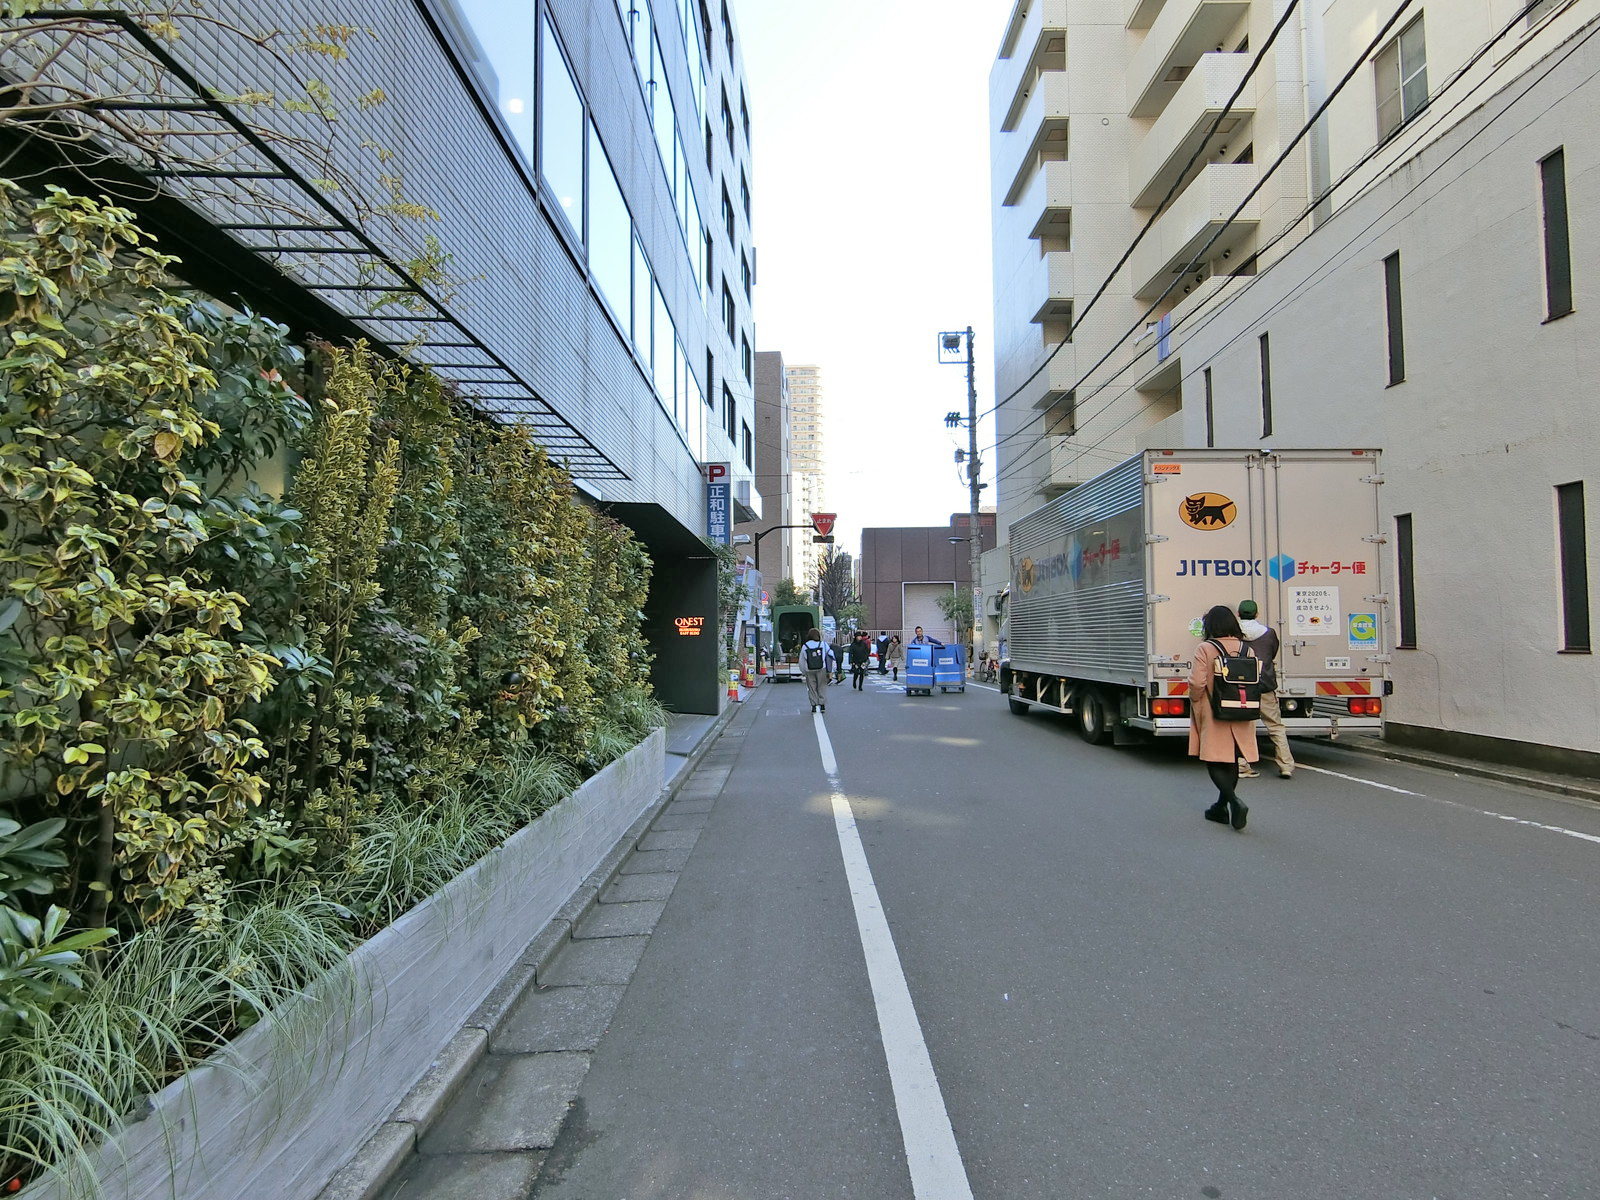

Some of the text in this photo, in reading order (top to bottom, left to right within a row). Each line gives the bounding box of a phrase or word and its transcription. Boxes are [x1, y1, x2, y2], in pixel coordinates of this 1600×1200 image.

[709, 465, 725, 482] P
[1176, 559, 1262, 576] JITBOX
[1297, 561, 1366, 575] チャーター便
